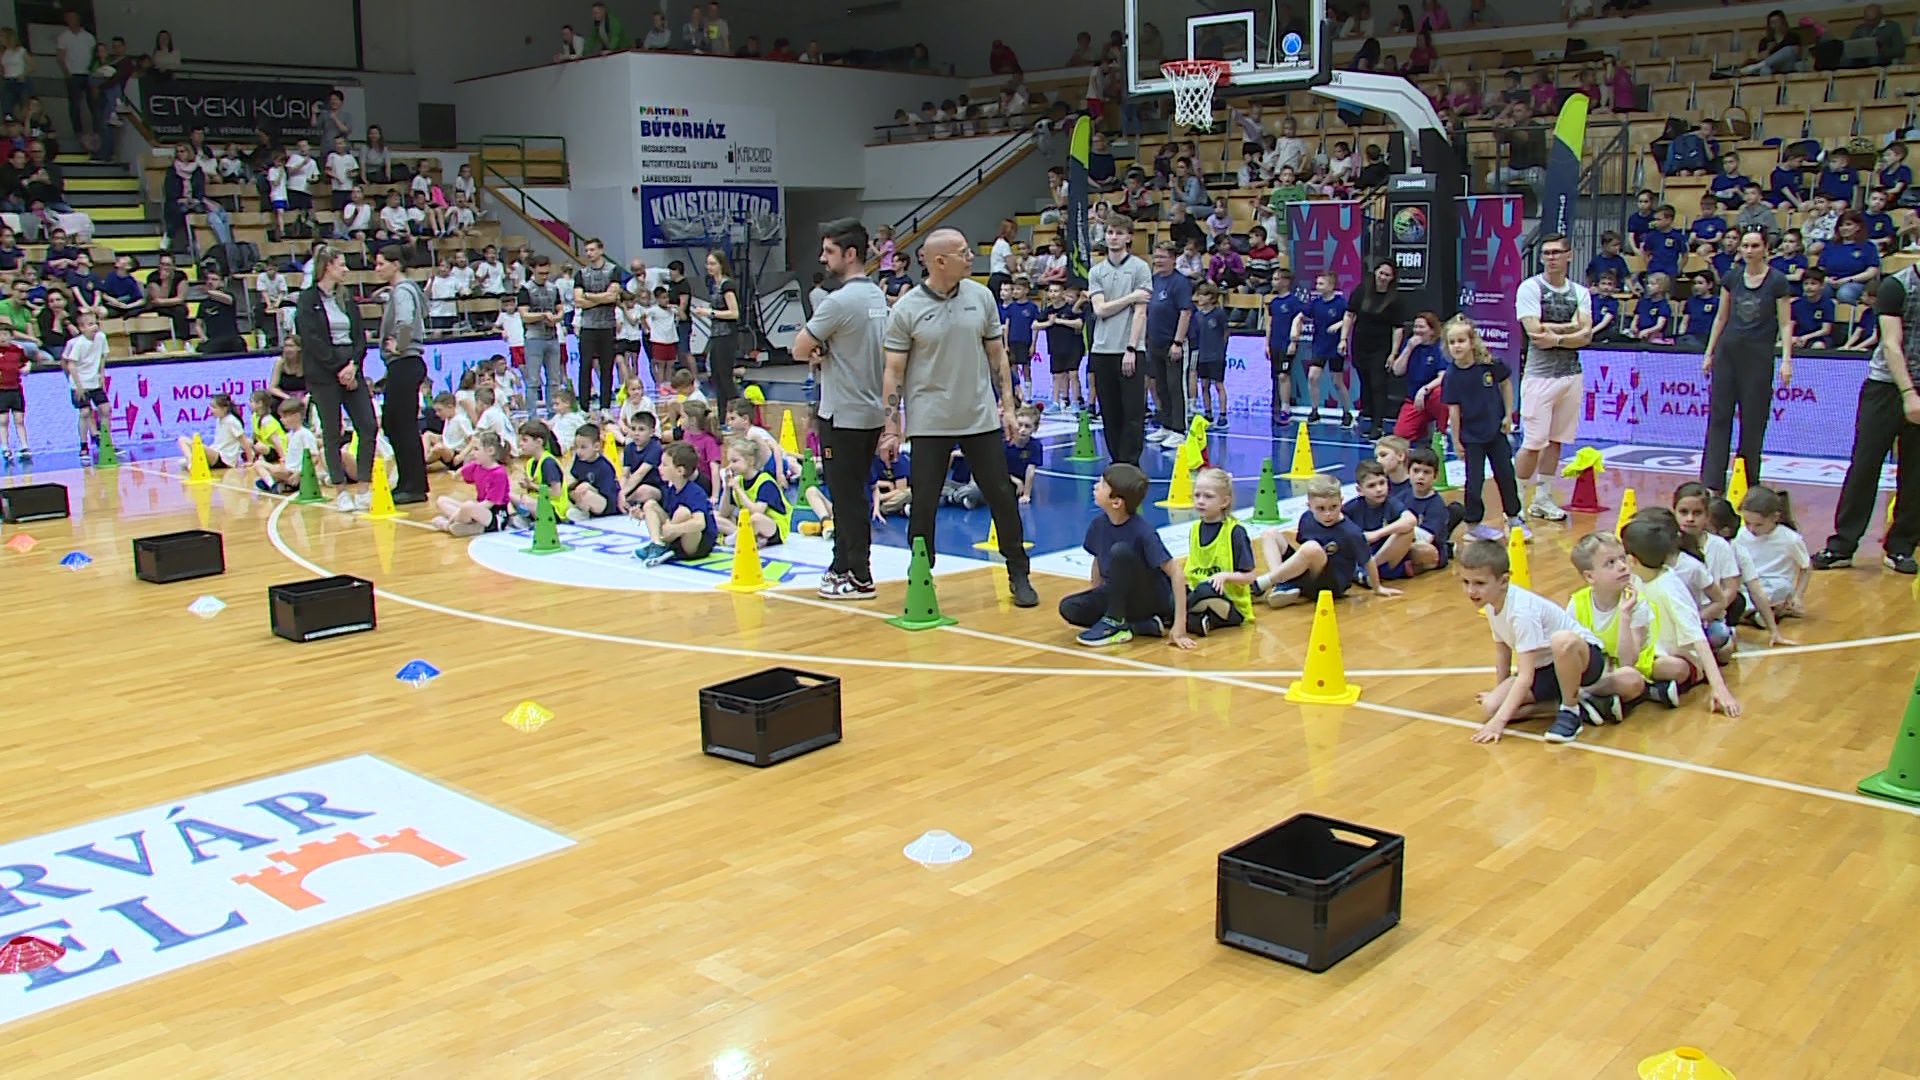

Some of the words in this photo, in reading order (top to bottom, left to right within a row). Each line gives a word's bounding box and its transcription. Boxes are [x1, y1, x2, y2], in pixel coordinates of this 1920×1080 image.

[151, 95, 245, 117] ETYEKI
[640, 106, 689, 117] PARTNER
[640, 117, 726, 139] BÚTORHÁZ
[1396, 252, 1421, 267] FIBA
[172, 378, 244, 400] MOL-ÚJ
[1660, 381, 1712, 398] MOL-
[1776, 387, 1817, 402] OPA
